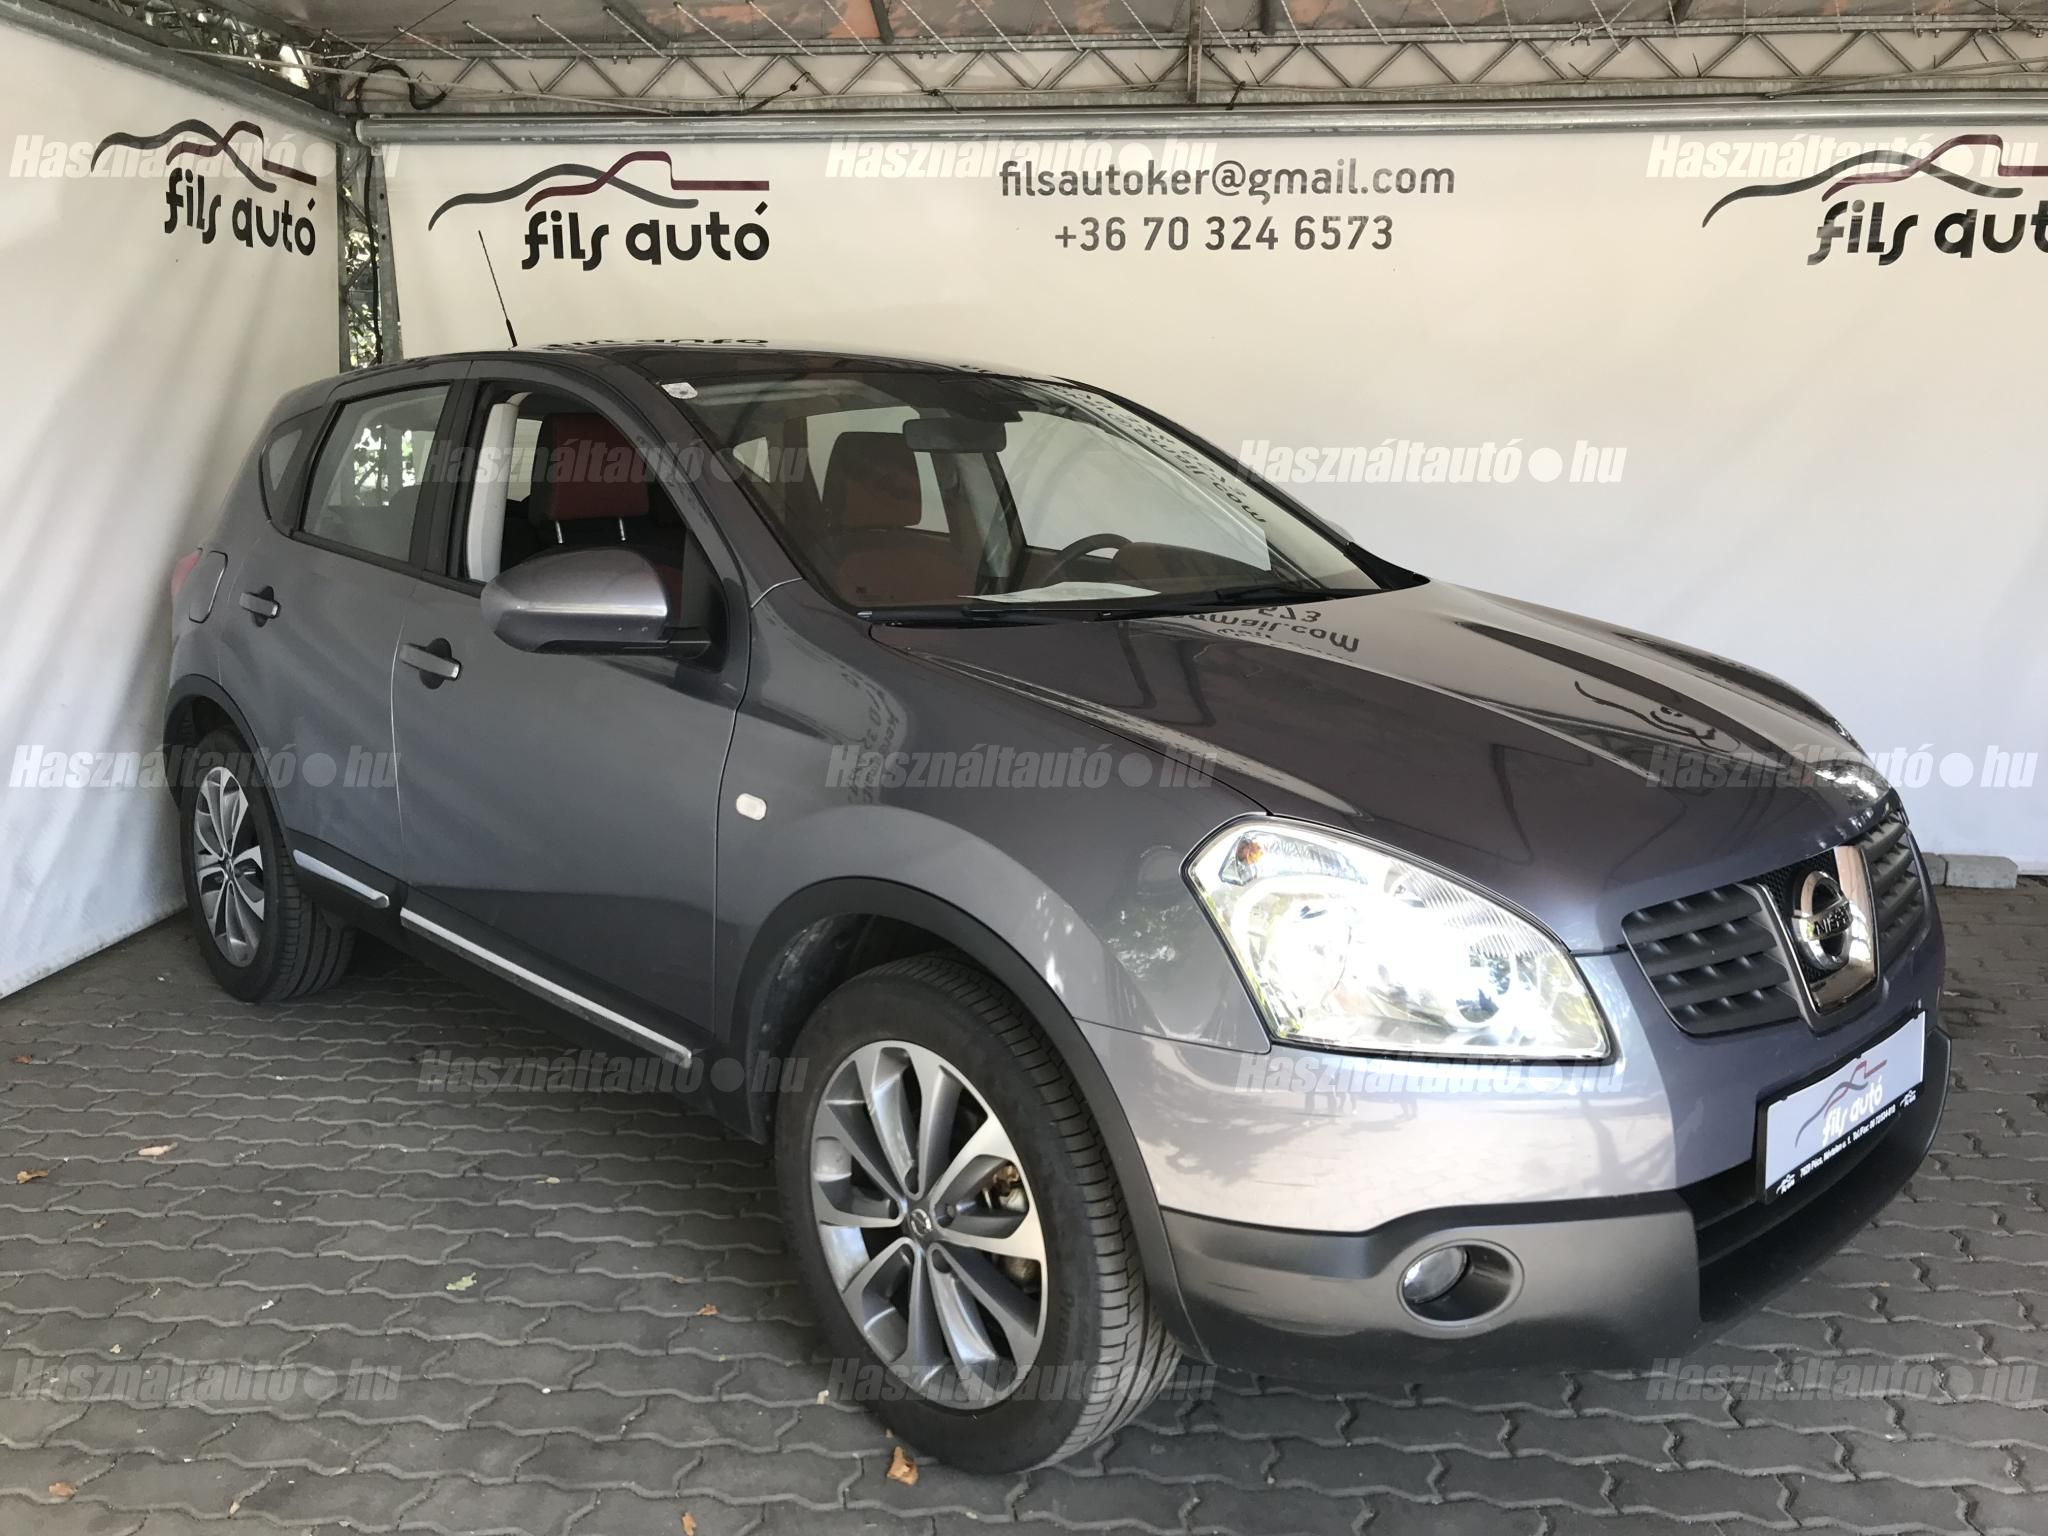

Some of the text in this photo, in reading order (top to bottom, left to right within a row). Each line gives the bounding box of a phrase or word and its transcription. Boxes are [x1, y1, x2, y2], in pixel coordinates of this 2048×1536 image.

[164, 167, 317, 256] fils autó
[1000, 158, 1455, 204] filsautoker@gmail.com
[522, 200, 770, 270] fils autó
[1055, 216, 1393, 251] +36 70 324 6573
[1807, 199, 1918, 266] fils
